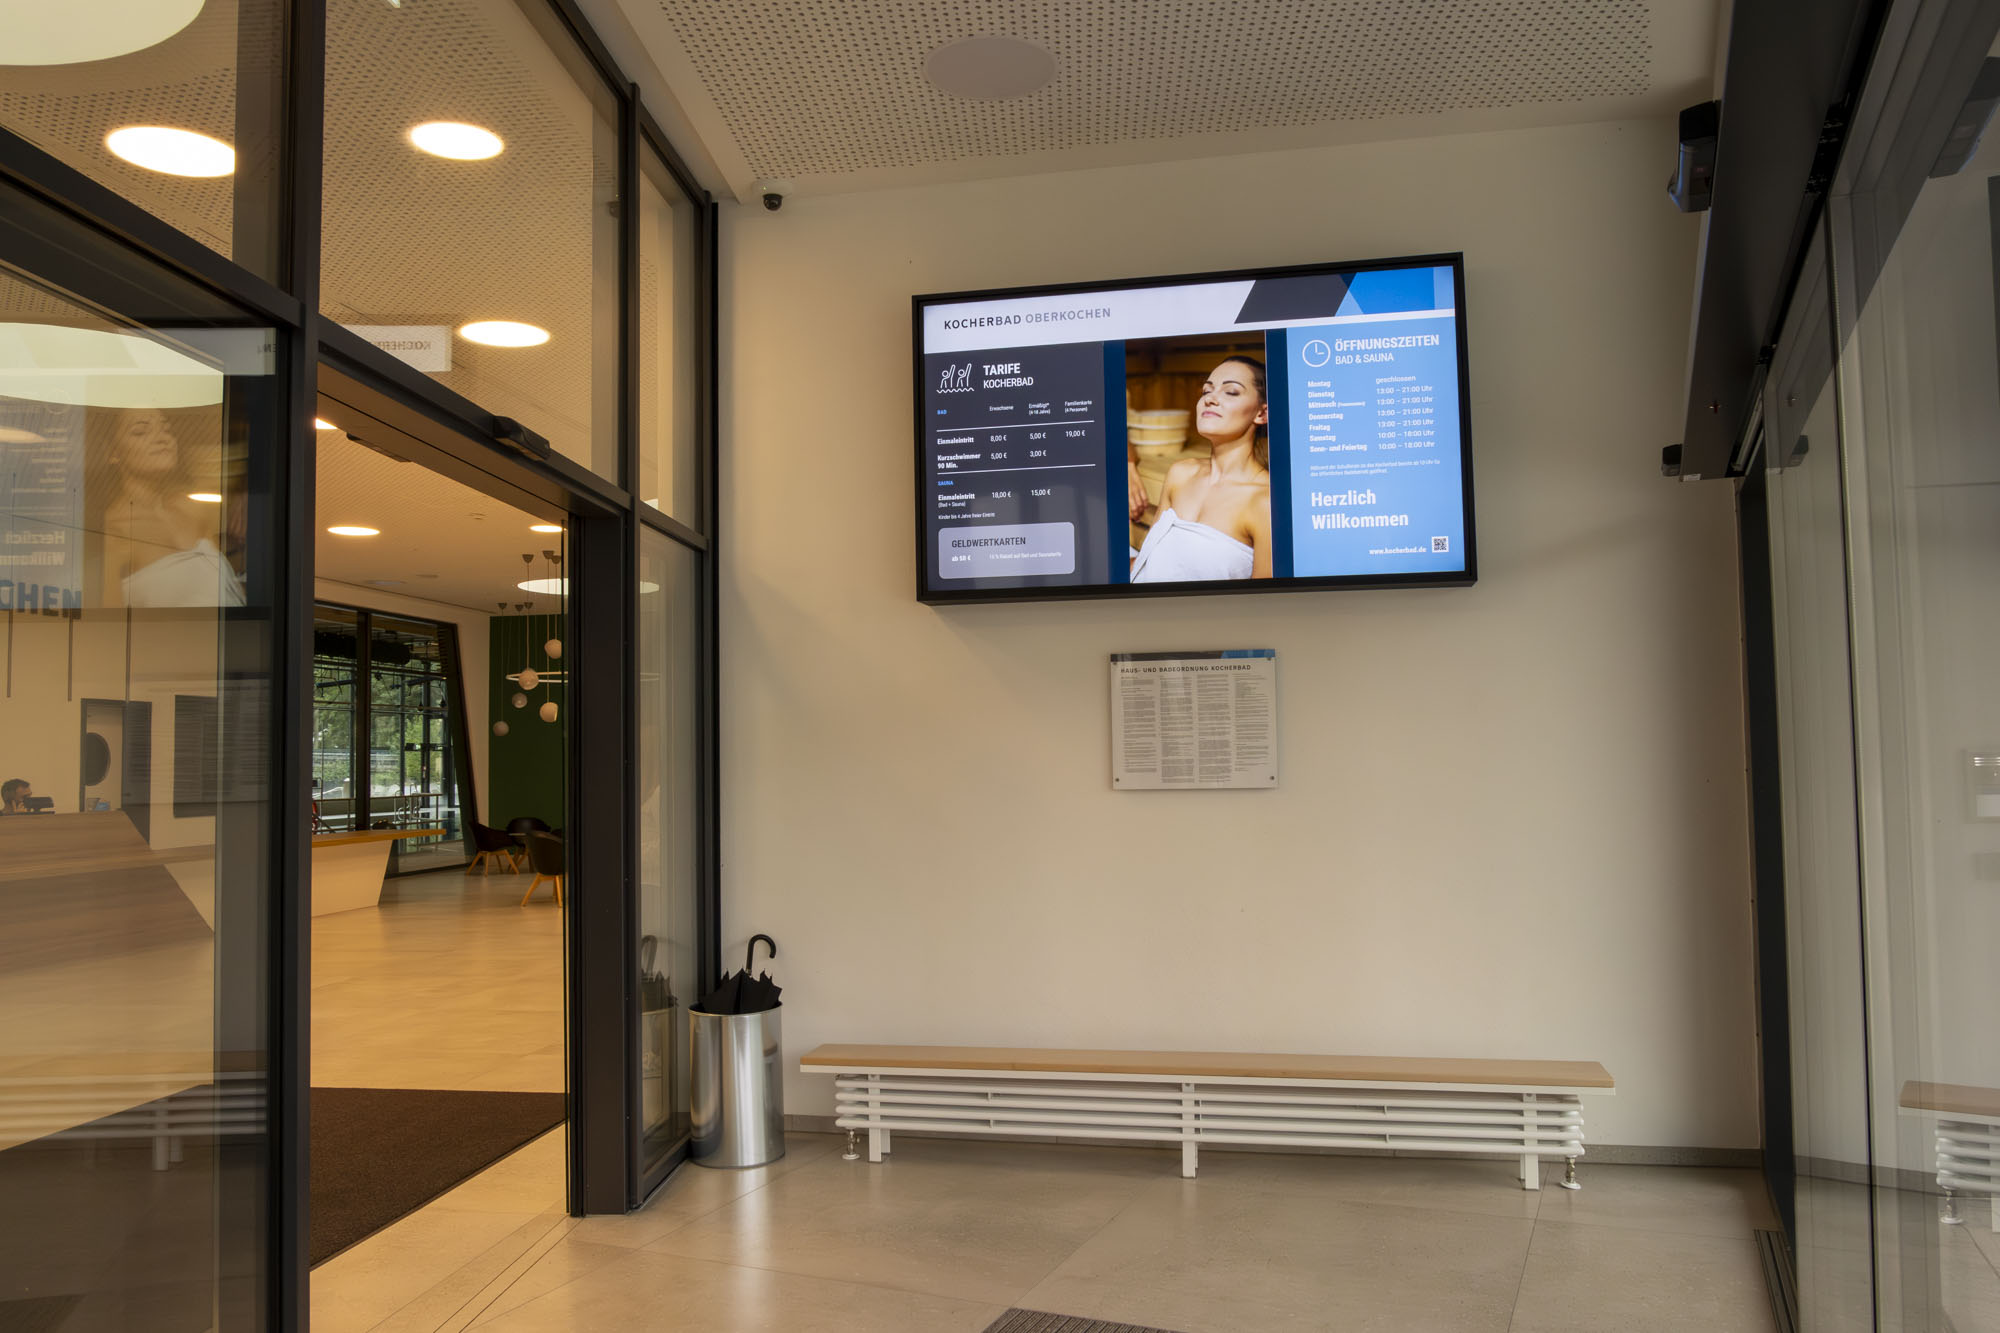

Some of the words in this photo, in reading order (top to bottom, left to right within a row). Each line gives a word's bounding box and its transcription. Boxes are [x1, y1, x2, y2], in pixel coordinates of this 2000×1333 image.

[944, 314, 1022, 330] KOCHERBAD
[1025, 308, 1111, 324] OBERKOCHEN
[1335, 334, 1440, 352] ÖFFNUNGSZEITEN
[1336, 354, 1353, 365] BAD
[1355, 354, 1362, 364] &
[1363, 352, 1394, 363] SAUNA
[983, 362, 1021, 376] TARIFE
[984, 376, 1034, 389] KOCHERBAD
[1376, 376, 1416, 384] geschlossen
[937, 437, 974, 445] Einmaleintritt
[937, 453, 980, 461] Kurzschwimmer
[1311, 489, 1376, 506] Herzlich
[1312, 513, 1408, 529] Willkommen
[952, 537, 1026, 548] GELDWERTKARTEN
[1369, 546, 1427, 554] www.kocherbad.de
